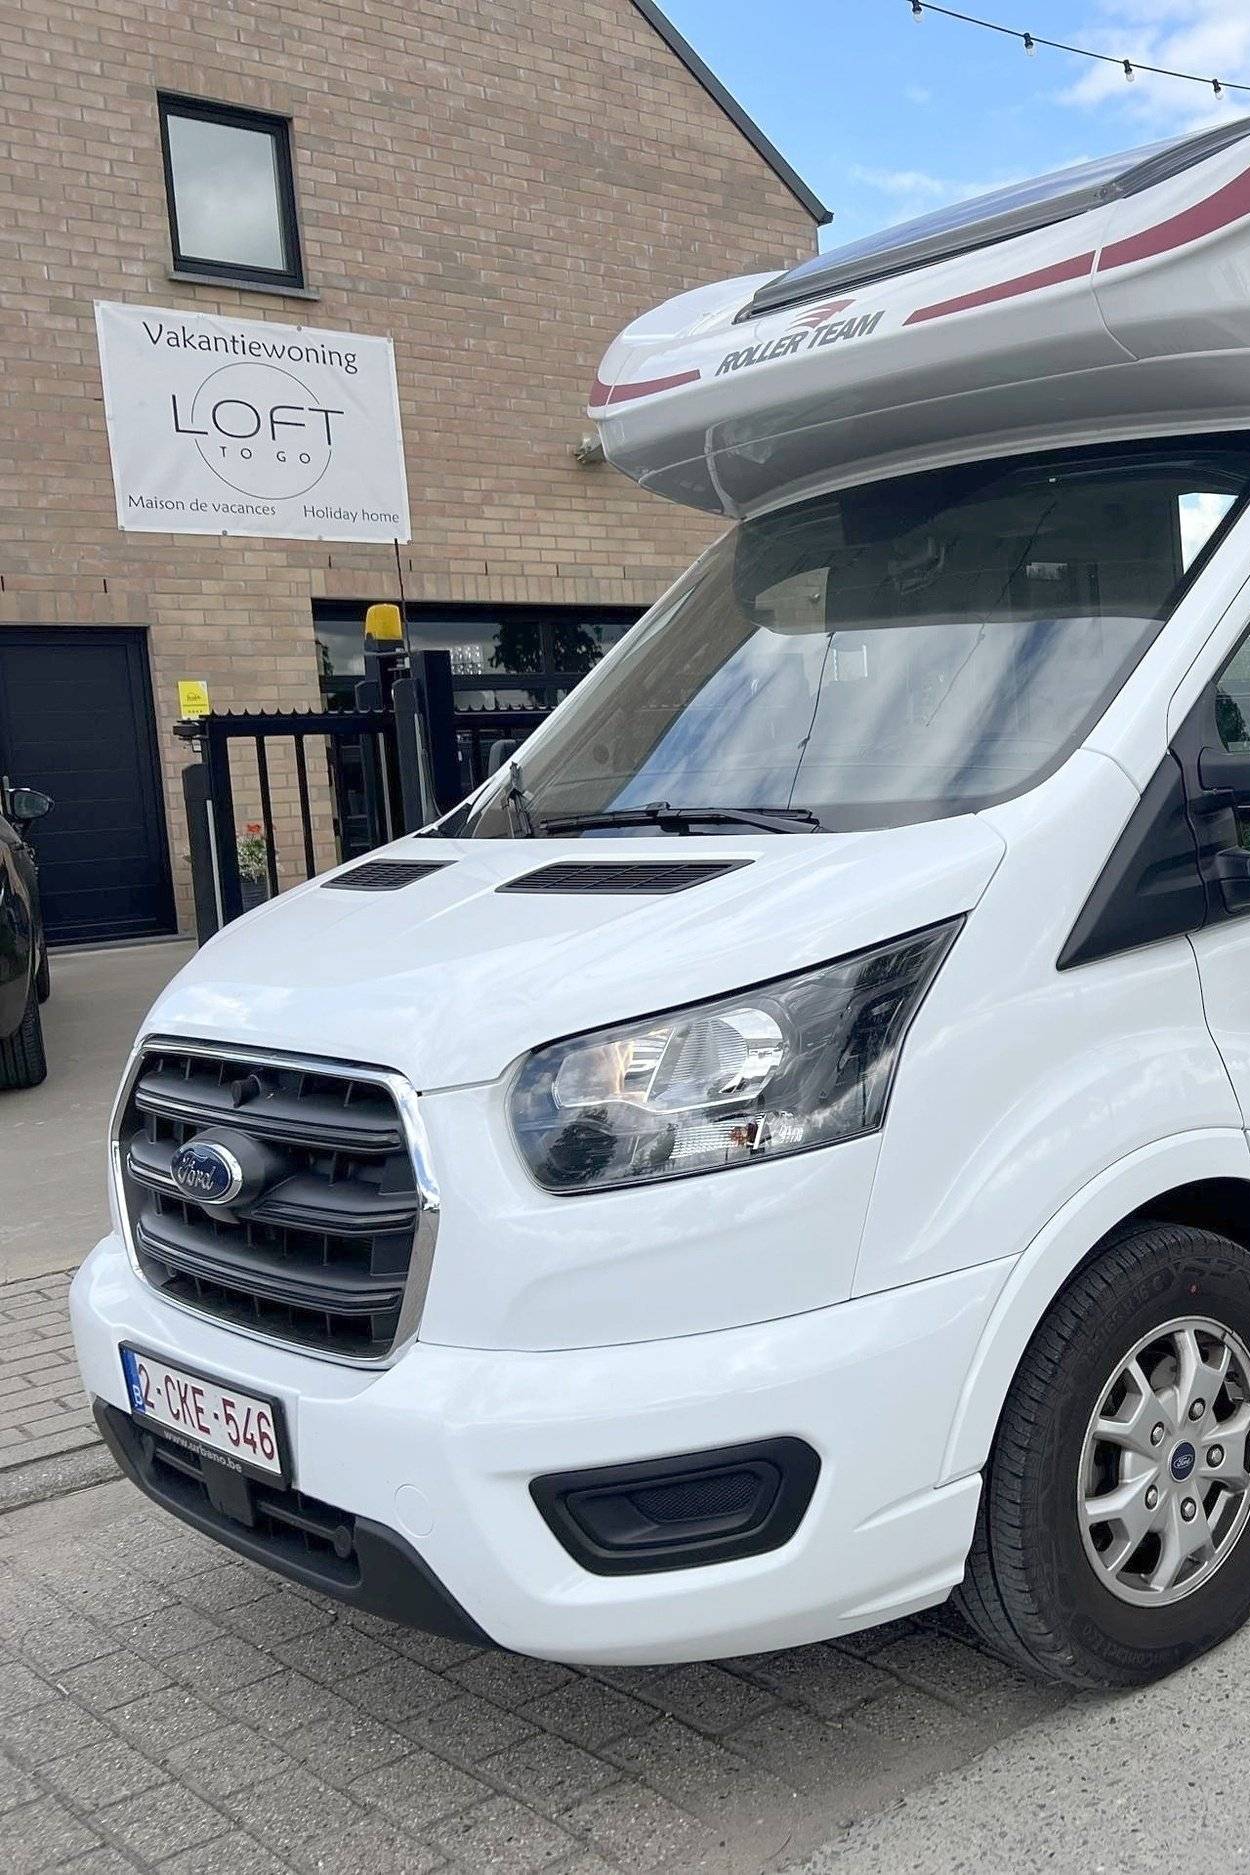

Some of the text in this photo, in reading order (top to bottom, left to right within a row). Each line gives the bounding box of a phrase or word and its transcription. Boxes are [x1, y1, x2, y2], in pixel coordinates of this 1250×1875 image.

[142, 321, 358, 374] Vakantiewoning
[715, 310, 886, 376] ROLLER TEAM
[172, 394, 344, 446] LOFT
[219, 446, 311, 464] TO GO
[128, 495, 276, 516] Maison de vacances
[303, 505, 400, 524] Holiday home
[178, 1151, 216, 1190] Ford
